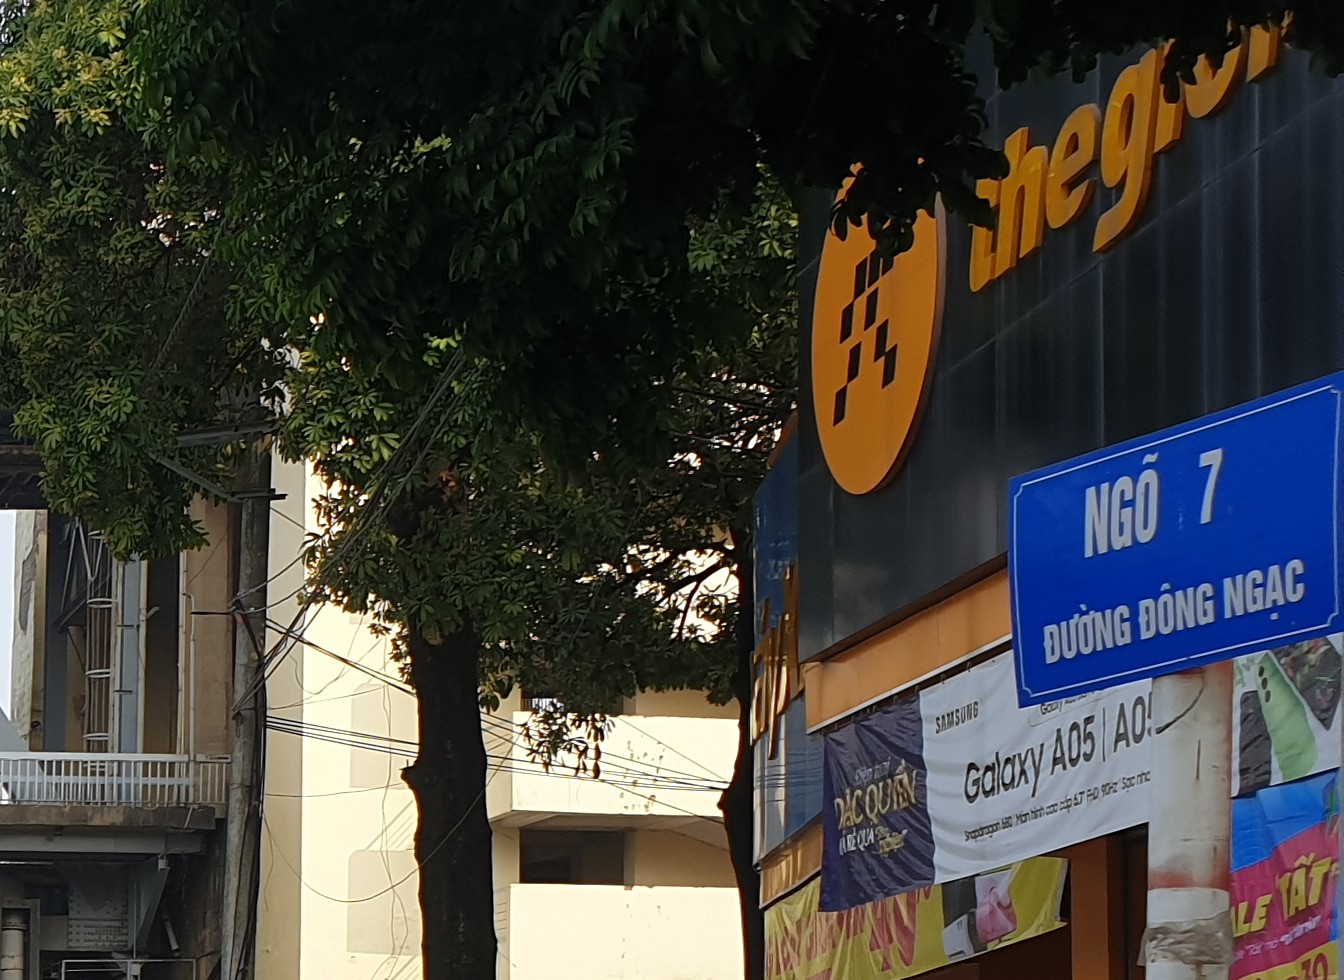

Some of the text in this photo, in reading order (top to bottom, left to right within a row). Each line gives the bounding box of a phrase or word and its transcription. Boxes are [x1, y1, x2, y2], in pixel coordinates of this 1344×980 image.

[1084, 448, 1224, 558] NGÕ 7
[1043, 559, 1305, 664] ĐƯỜNG ĐÔNG NGẠC
[935, 701, 979, 734] SAMSUNG
[964, 742, 1045, 804] Galaxy
[1050, 714, 1096, 776] A05
